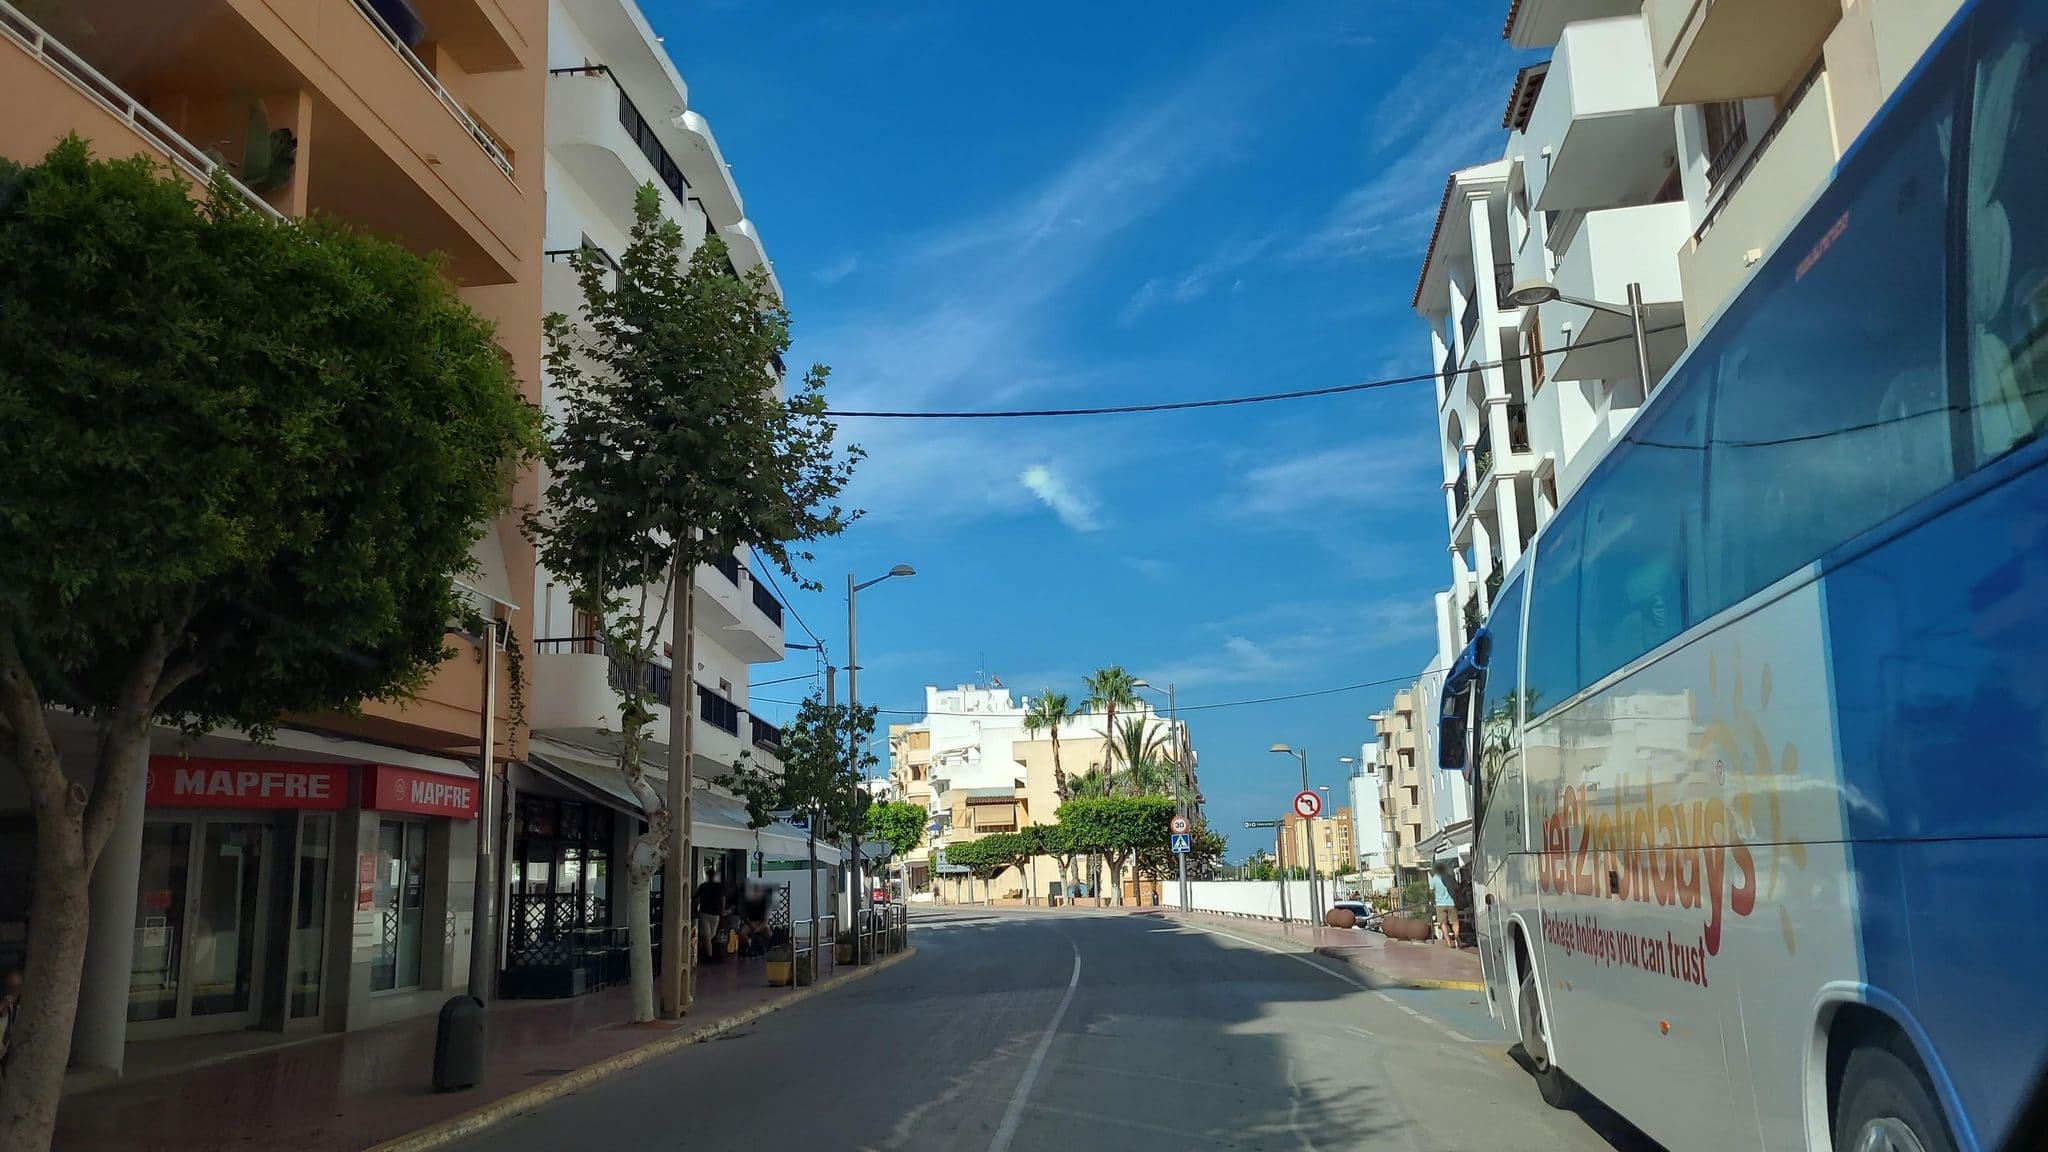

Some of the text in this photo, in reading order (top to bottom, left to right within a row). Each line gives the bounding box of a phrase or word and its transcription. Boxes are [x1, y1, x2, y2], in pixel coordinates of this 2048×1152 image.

[174, 769, 330, 799] MAPFRE
[411, 779, 471, 809] MAPFRE
[1174, 821, 1185, 829] 30
[1541, 908, 1708, 988] Package holidays you can trust
